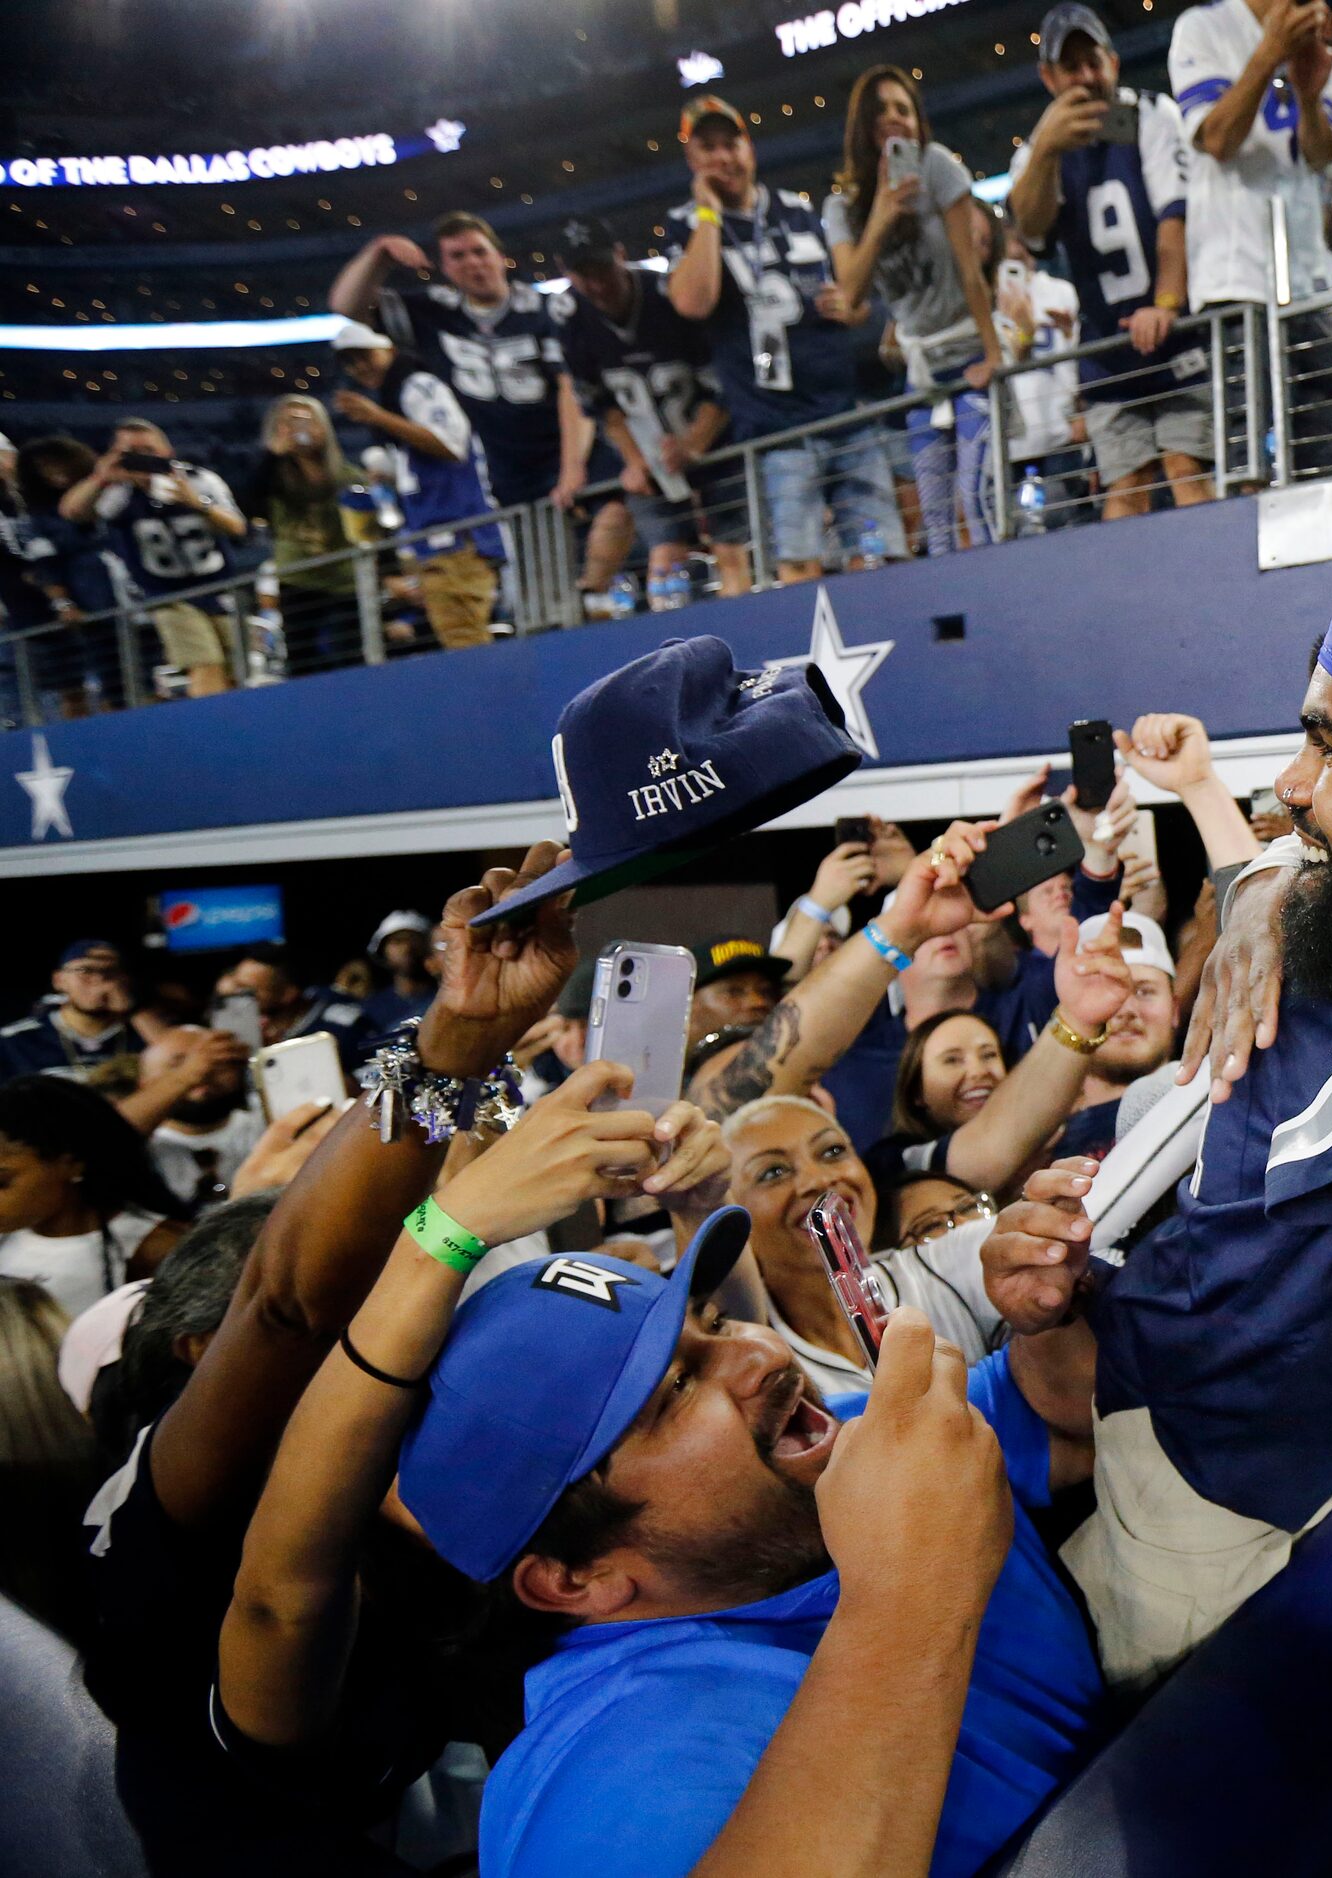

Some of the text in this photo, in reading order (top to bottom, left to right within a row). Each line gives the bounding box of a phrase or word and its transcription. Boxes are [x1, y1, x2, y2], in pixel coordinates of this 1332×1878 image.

[775, 10, 837, 57] THE
[9, 158, 58, 187] OF
[58, 156, 129, 185] THE
[128, 153, 251, 185] DALLAS
[248, 133, 397, 178] COWBOYS
[1087, 179, 1150, 305] 9
[438, 330, 546, 404] 55
[131, 515, 226, 579] 82
[627, 759, 726, 821] IRVIN
